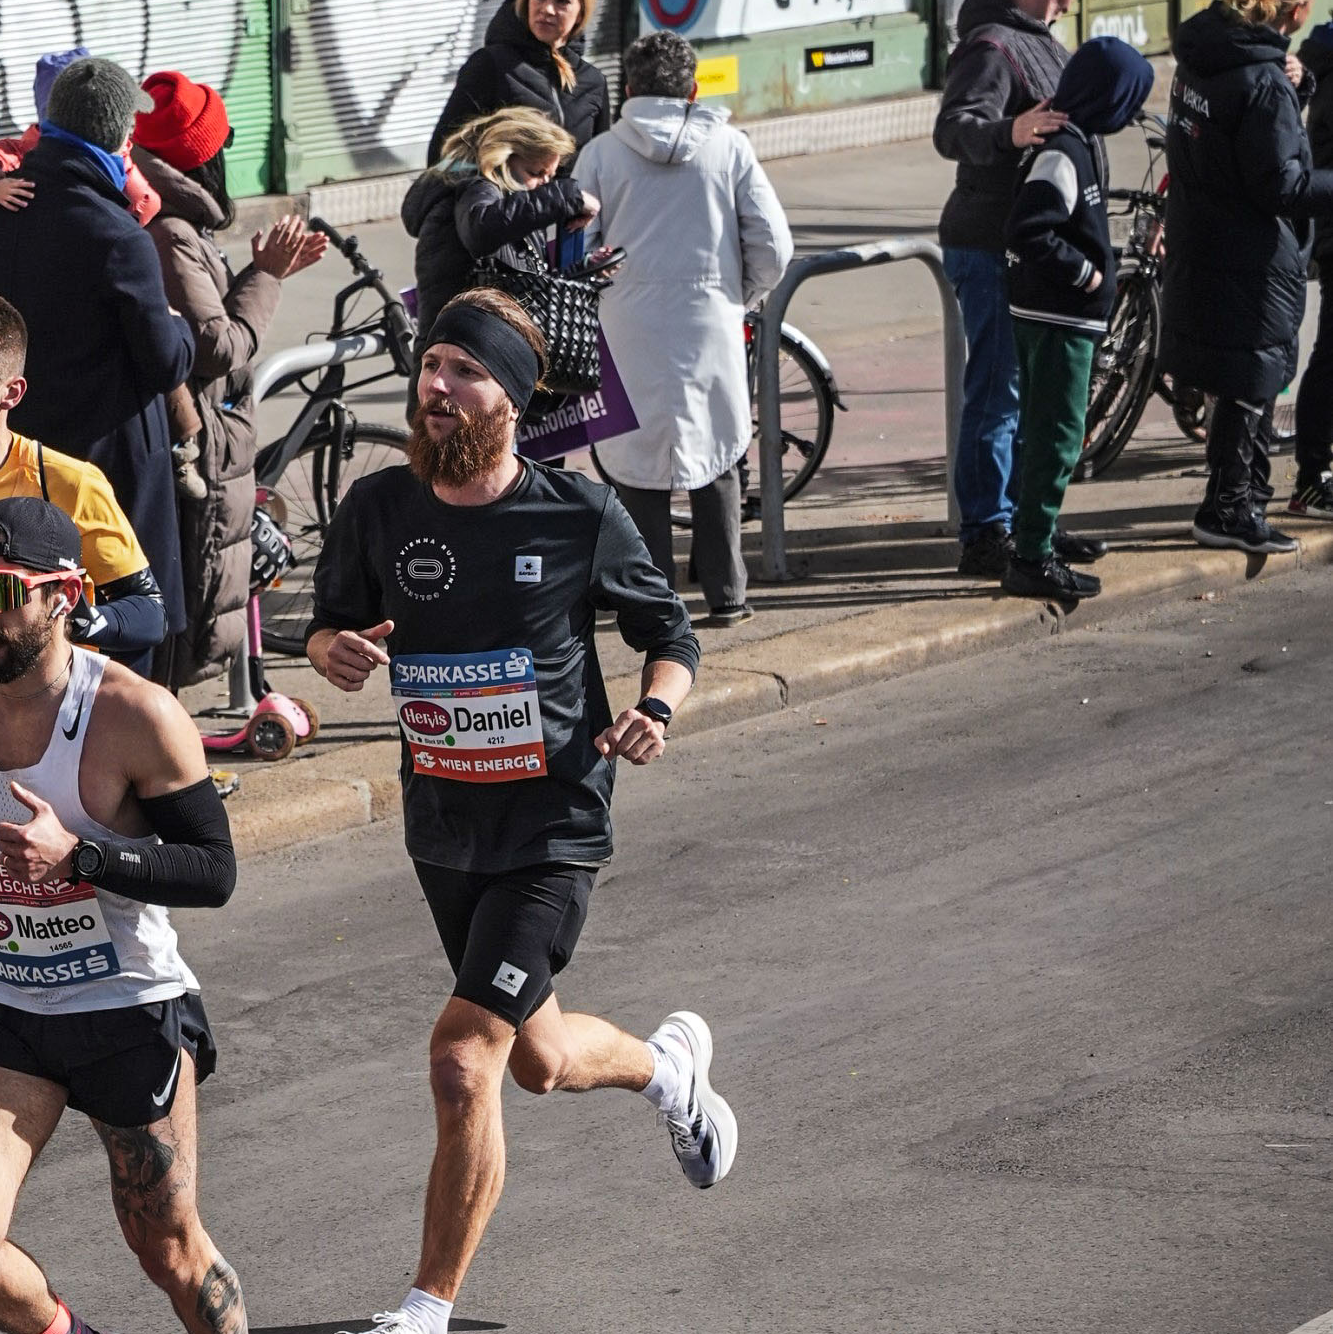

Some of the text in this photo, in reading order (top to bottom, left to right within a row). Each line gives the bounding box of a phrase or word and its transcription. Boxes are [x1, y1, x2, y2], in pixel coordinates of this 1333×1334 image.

[399, 537, 435, 556] VIENNA
[400, 662, 503, 683] SPARKASSE
[403, 701, 532, 733] Hervis Daniel
[487, 735, 505, 745] 4212
[438, 756, 472, 772] WIEN
[15, 914, 96, 941] Matteo
[49, 940, 74, 953] 14565
